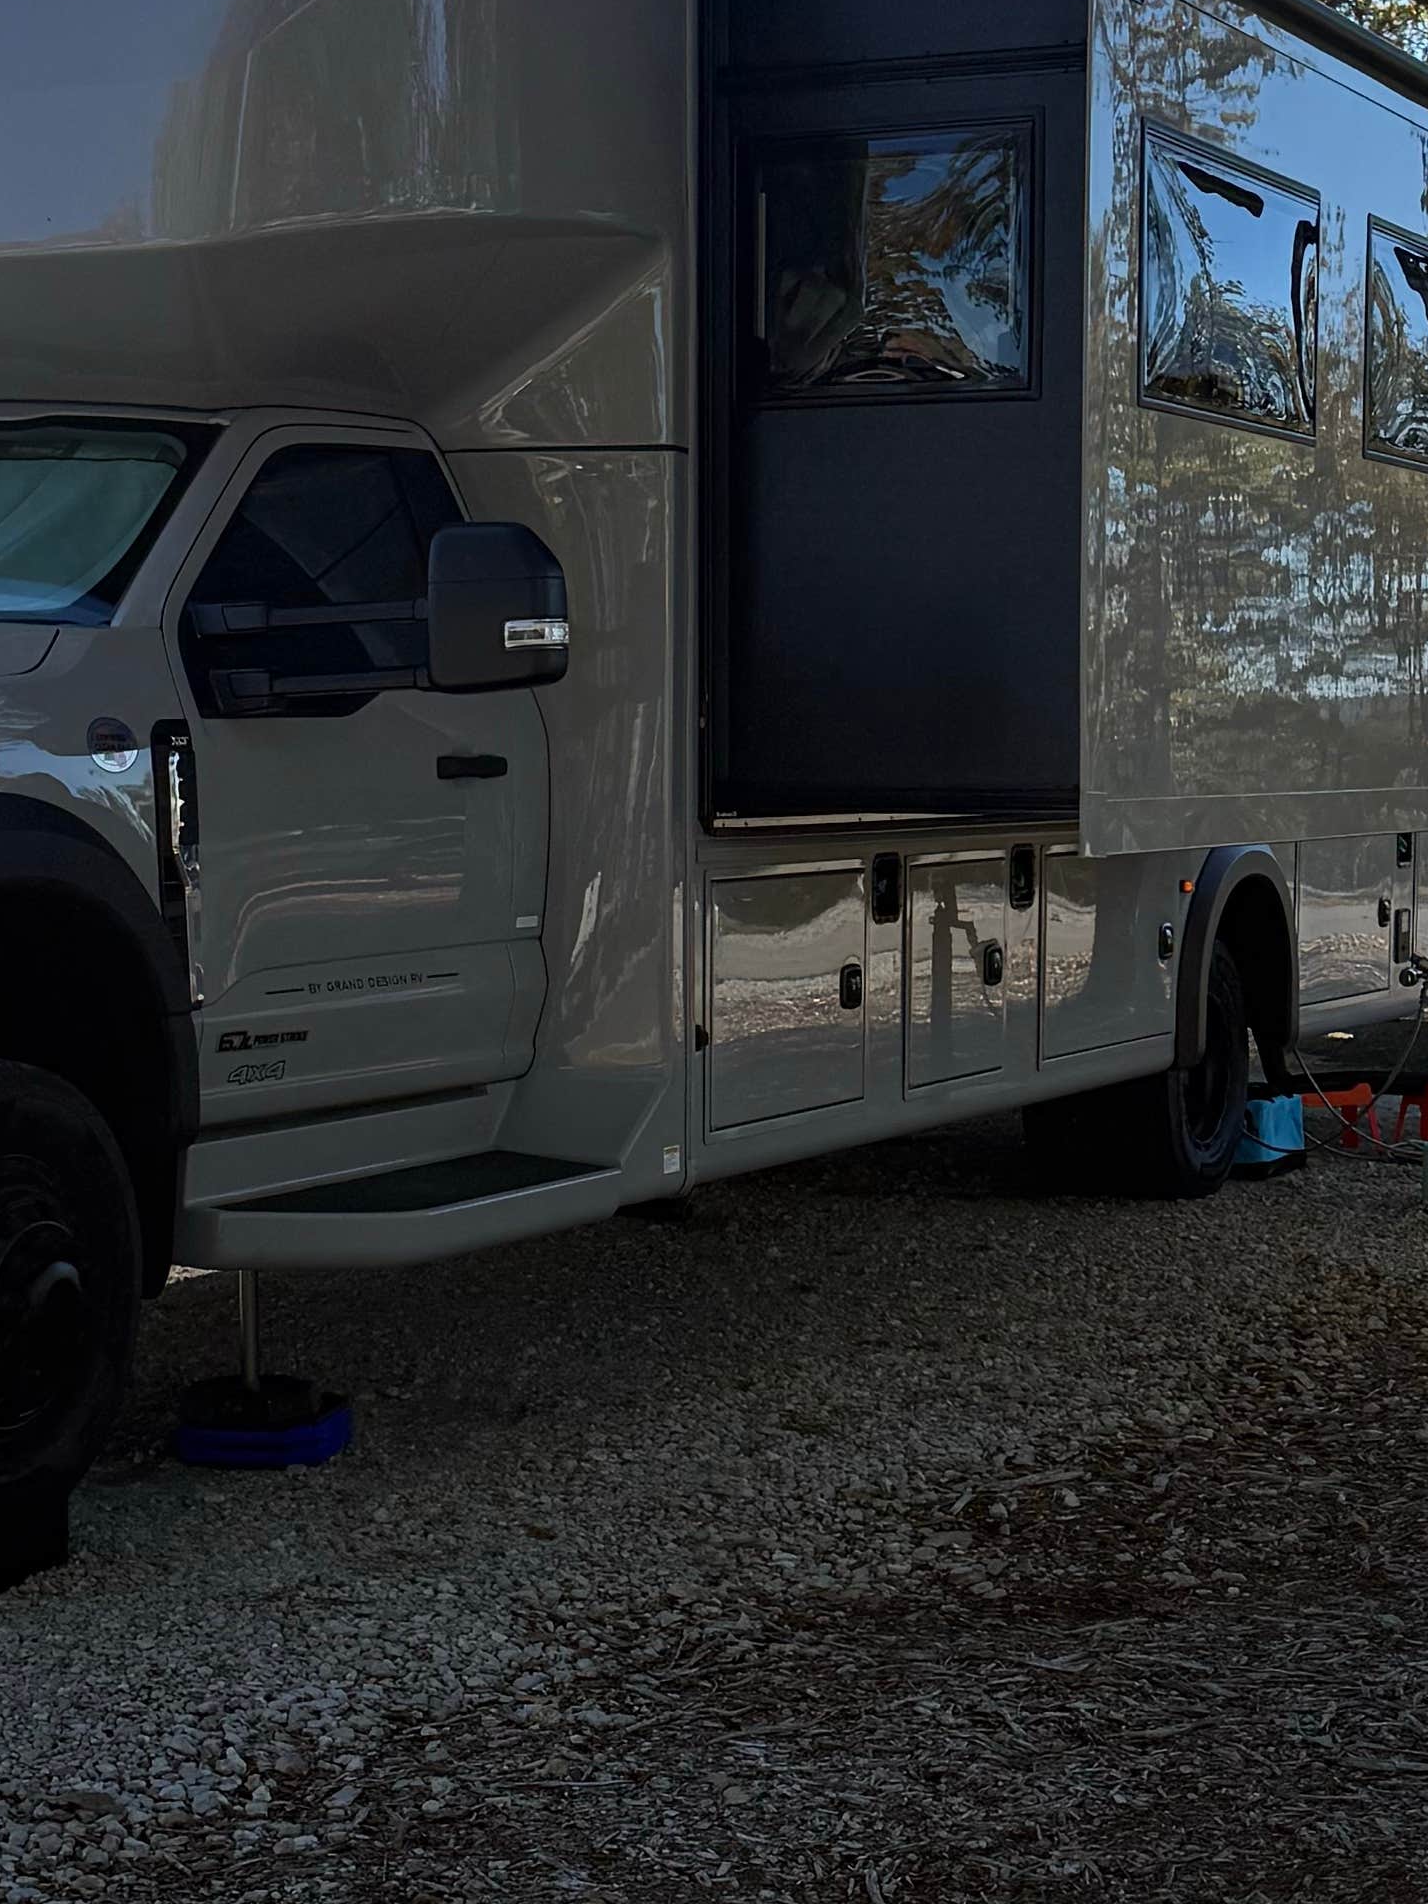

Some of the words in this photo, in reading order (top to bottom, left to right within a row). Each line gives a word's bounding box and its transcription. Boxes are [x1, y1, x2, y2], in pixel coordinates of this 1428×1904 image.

[308, 983, 322, 994] BY
[327, 978, 364, 992] GRAND
[368, 975, 407, 988] DESIGN
[410, 972, 423, 984] RV
